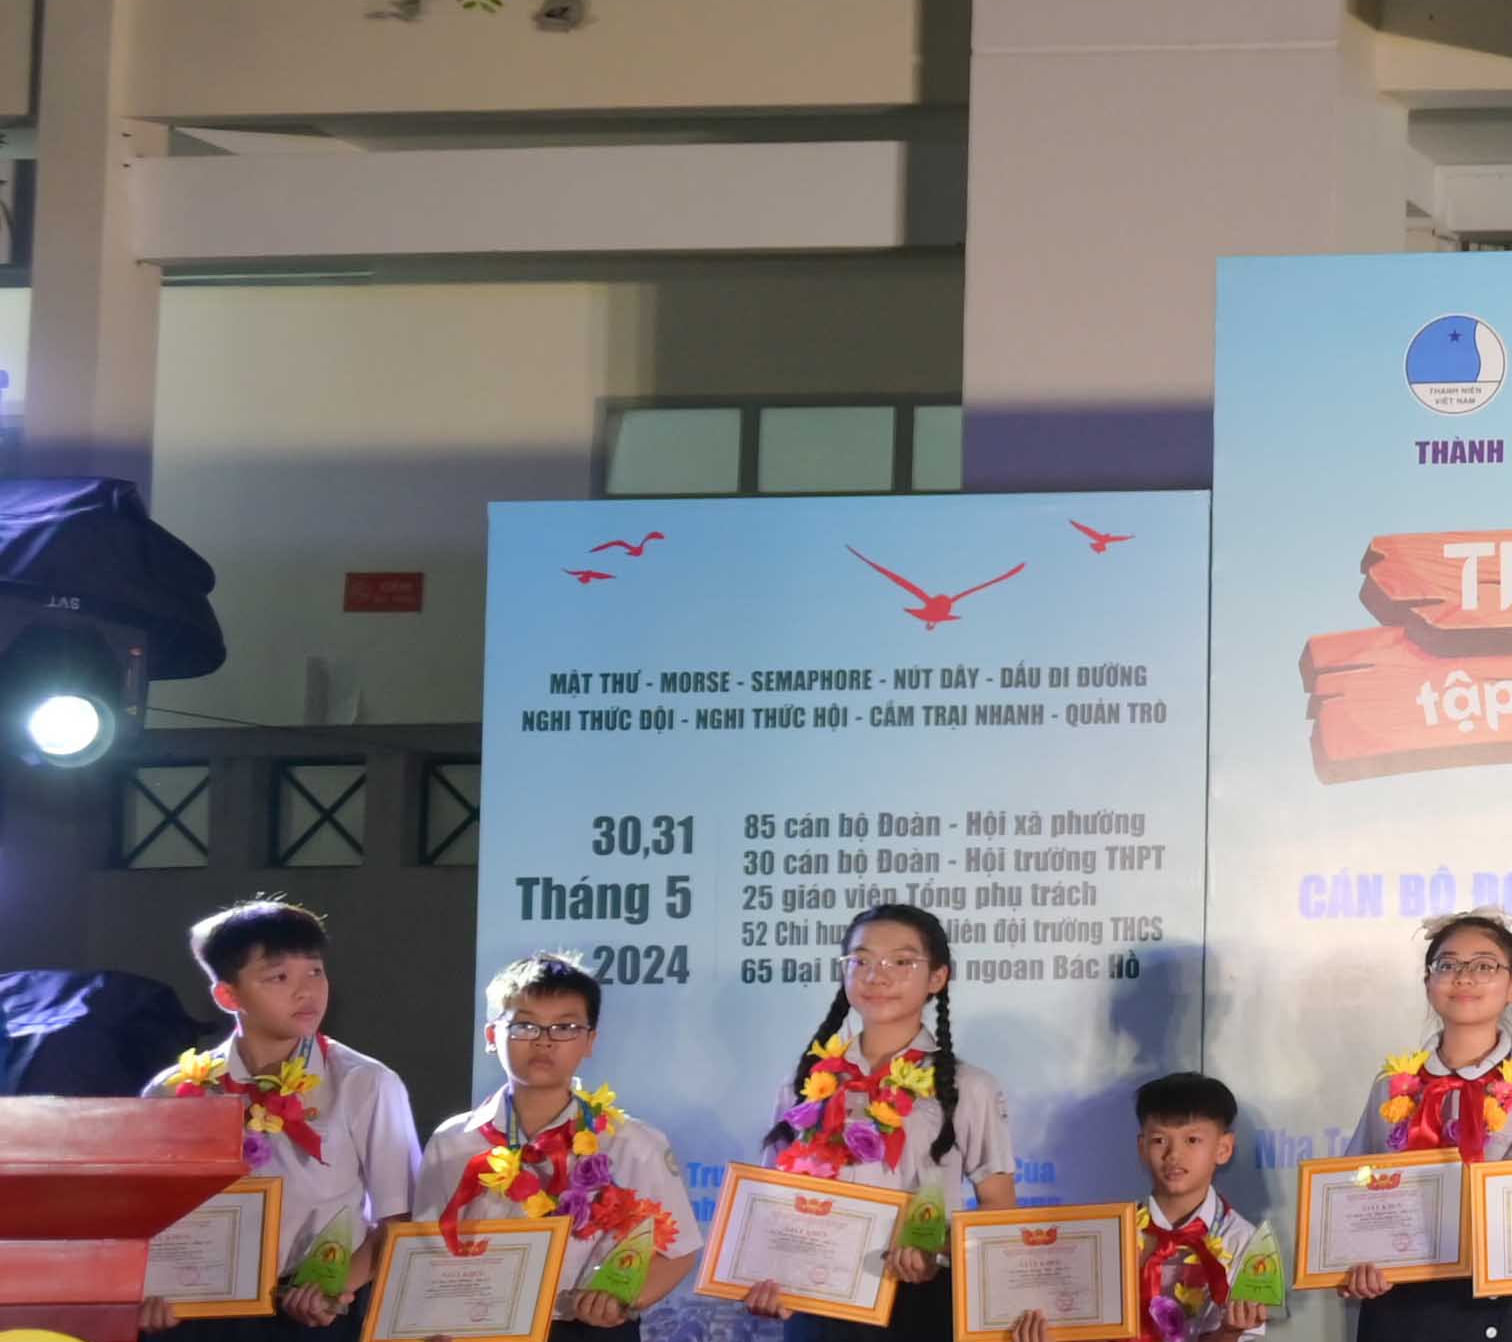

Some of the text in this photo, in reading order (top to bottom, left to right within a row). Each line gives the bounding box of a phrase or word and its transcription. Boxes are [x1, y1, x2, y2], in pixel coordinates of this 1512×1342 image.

[1415, 435, 1504, 464] THÀNH
[550, 669, 595, 697] MẬT
[660, 669, 730, 692] MORSE
[751, 668, 872, 692] SEMAPHORE
[893, 664, 934, 690] NÚT
[940, 664, 980, 690] DÂY
[1048, 666, 1071, 688] ĐI
[522, 710, 571, 731] NGHI
[638, 706, 674, 734] ĐỘI
[696, 708, 744, 729] NGHI
[812, 705, 848, 732] HỘI
[922, 703, 968, 729] TRẠI
[975, 703, 1044, 726] NHANH
[1127, 698, 1167, 724] TRÒ
[592, 815, 694, 859] 30,31
[744, 813, 776, 839] 85
[784, 810, 830, 838] cán
[839, 814, 868, 842] bộ
[877, 810, 941, 838] Đoàn
[966, 808, 1005, 839] Hội
[1051, 807, 1145, 843] phường
[744, 850, 775, 875] 30
[783, 846, 830, 874] cán
[838, 847, 867, 879] bộ
[877, 845, 940, 873] Đoàn
[966, 843, 1004, 875] Hội
[1013, 845, 1097, 875] trường
[1106, 844, 1166, 869] THPT
[516, 875, 692, 927] Tháng 5
[742, 886, 775, 910] 25
[783, 882, 835, 916] giáo
[905, 877, 966, 911] Tổng
[976, 881, 1026, 914] phụ
[1032, 880, 1096, 907] trách
[1300, 867, 1382, 919] CÁN
[742, 921, 766, 946] 52
[993, 918, 1027, 946] đội
[1033, 916, 1103, 947] trường
[1111, 917, 1163, 942] THCS
[742, 961, 772, 983] 65
[782, 958, 820, 986] Đại
[966, 960, 1043, 985] ngoan
[1053, 955, 1099, 980] Bác
[1256, 1130, 1312, 1168] Nha
